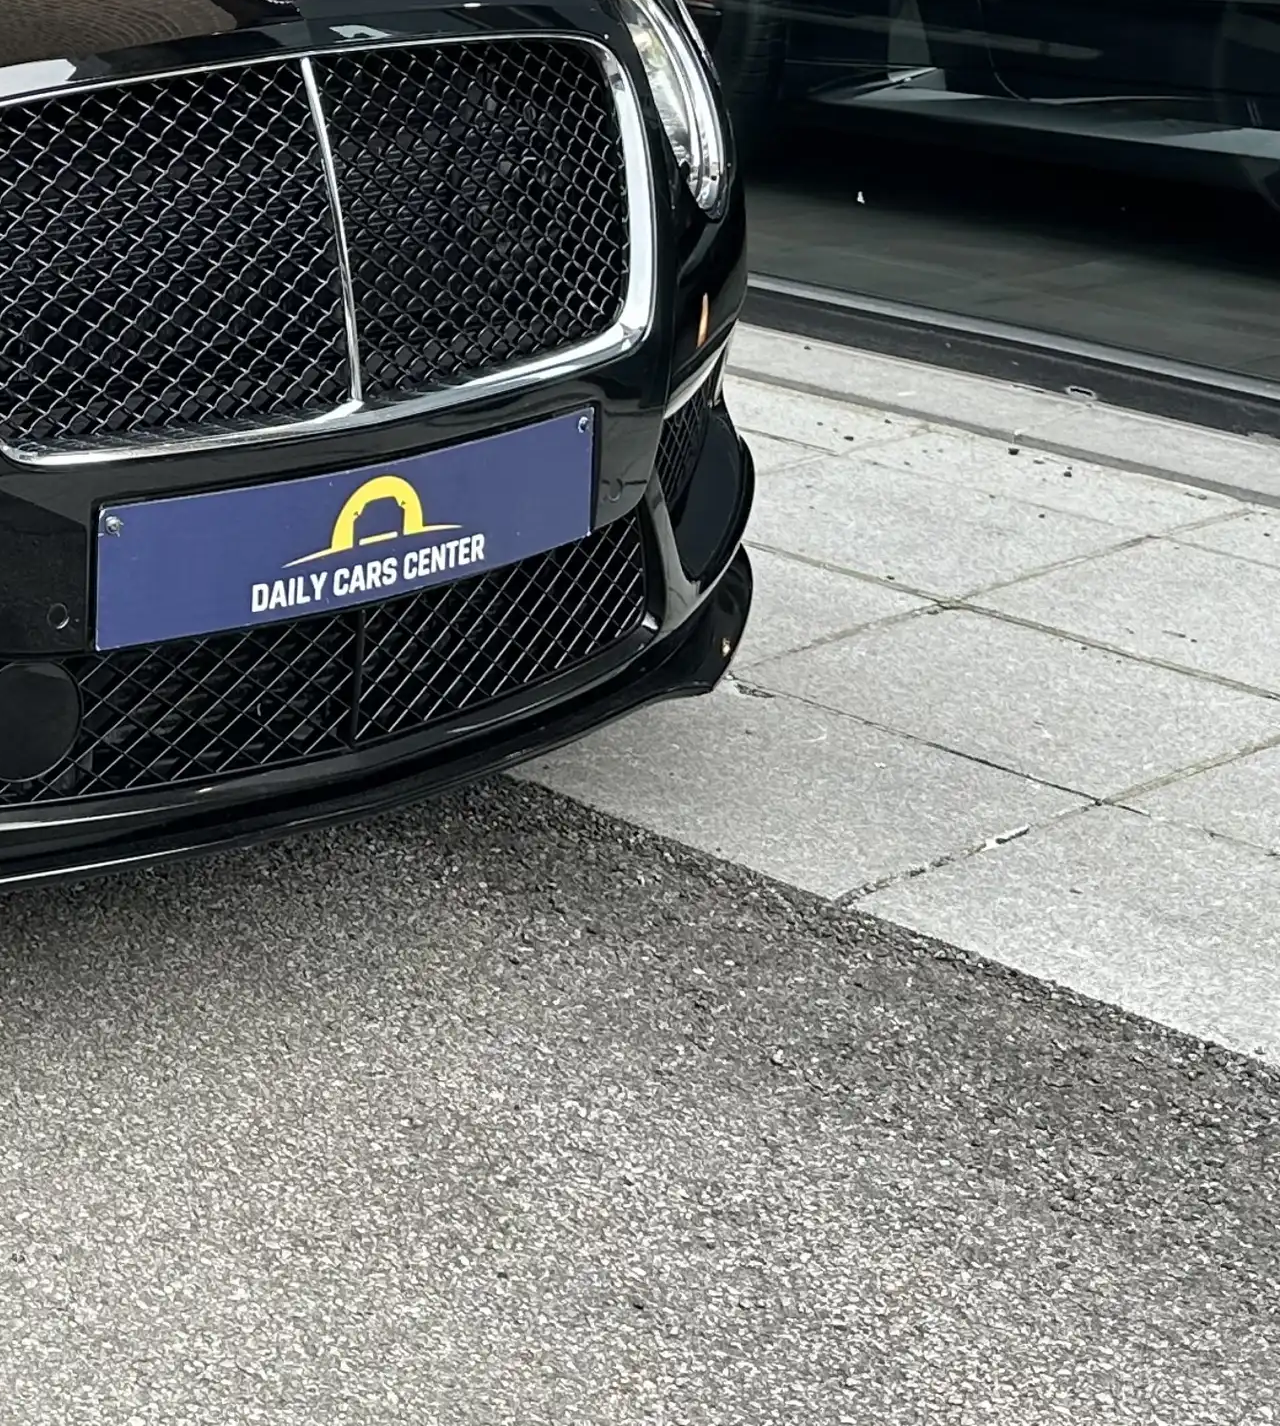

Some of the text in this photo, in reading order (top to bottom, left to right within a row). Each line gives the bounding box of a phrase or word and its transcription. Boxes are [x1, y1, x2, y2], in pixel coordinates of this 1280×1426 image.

[251, 533, 485, 613] DAILY CARS CENTER
